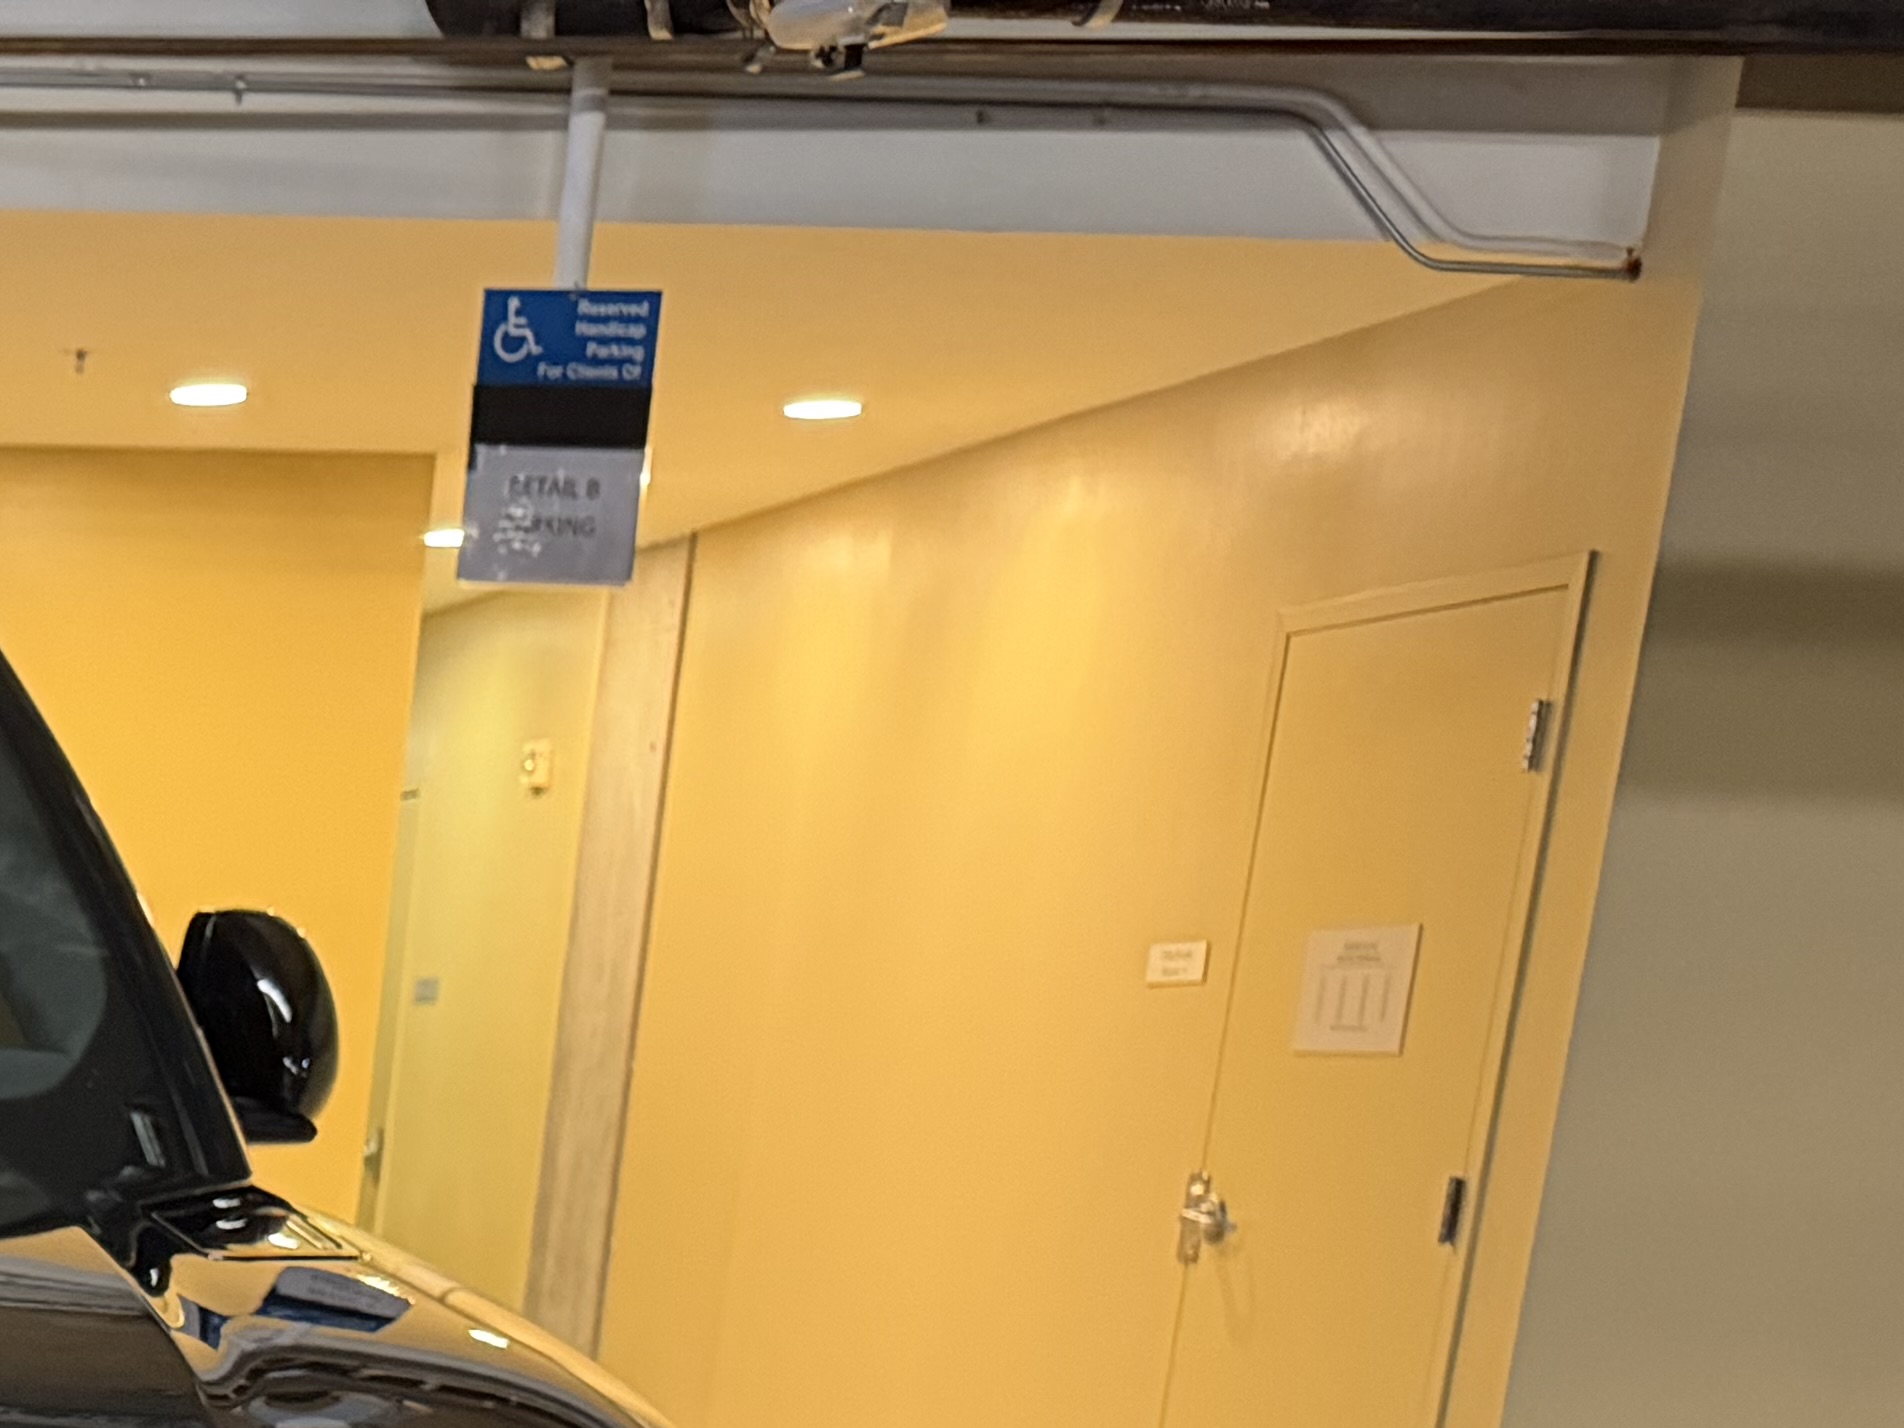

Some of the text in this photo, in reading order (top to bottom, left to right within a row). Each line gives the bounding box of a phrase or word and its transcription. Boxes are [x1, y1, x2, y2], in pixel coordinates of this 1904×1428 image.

[577, 298, 650, 317] Reserved
[575, 319, 647, 340] Handicap
[586, 341, 645, 363] Parking
[566, 362, 619, 381] Clients
